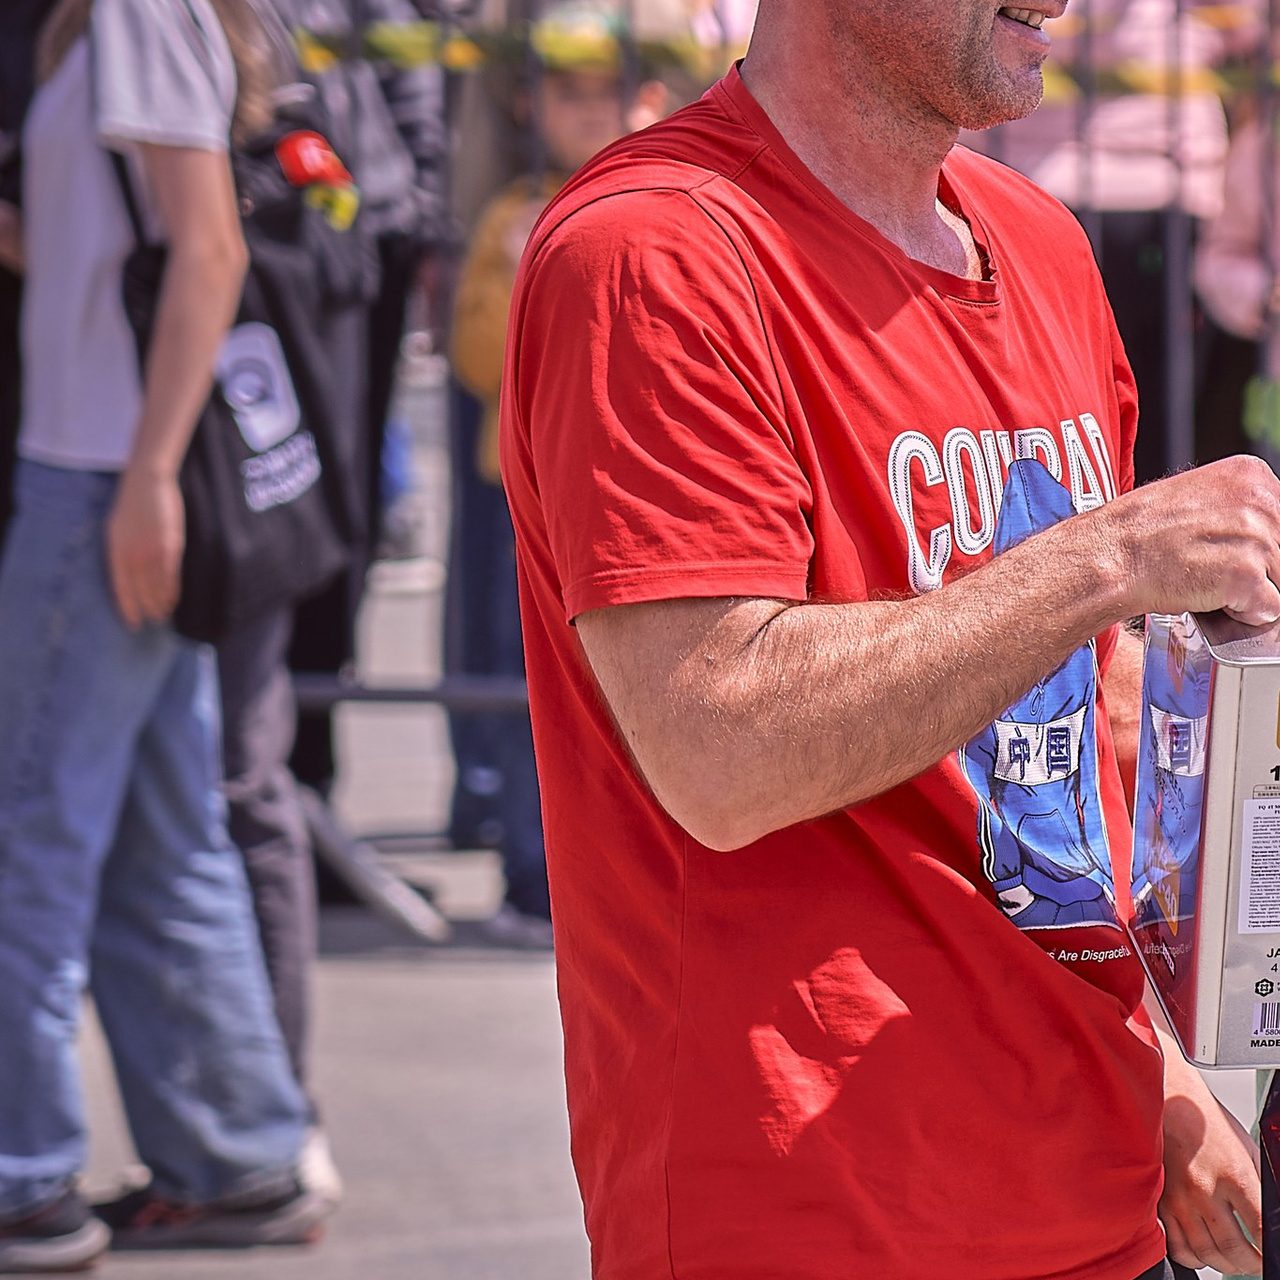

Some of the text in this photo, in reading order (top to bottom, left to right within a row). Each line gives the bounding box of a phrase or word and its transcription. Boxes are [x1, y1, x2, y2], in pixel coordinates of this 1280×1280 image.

[1008, 724, 1072, 780] 中国
[1057, 949, 1079, 961] Are
[1271, 963, 1278, 972] 4
